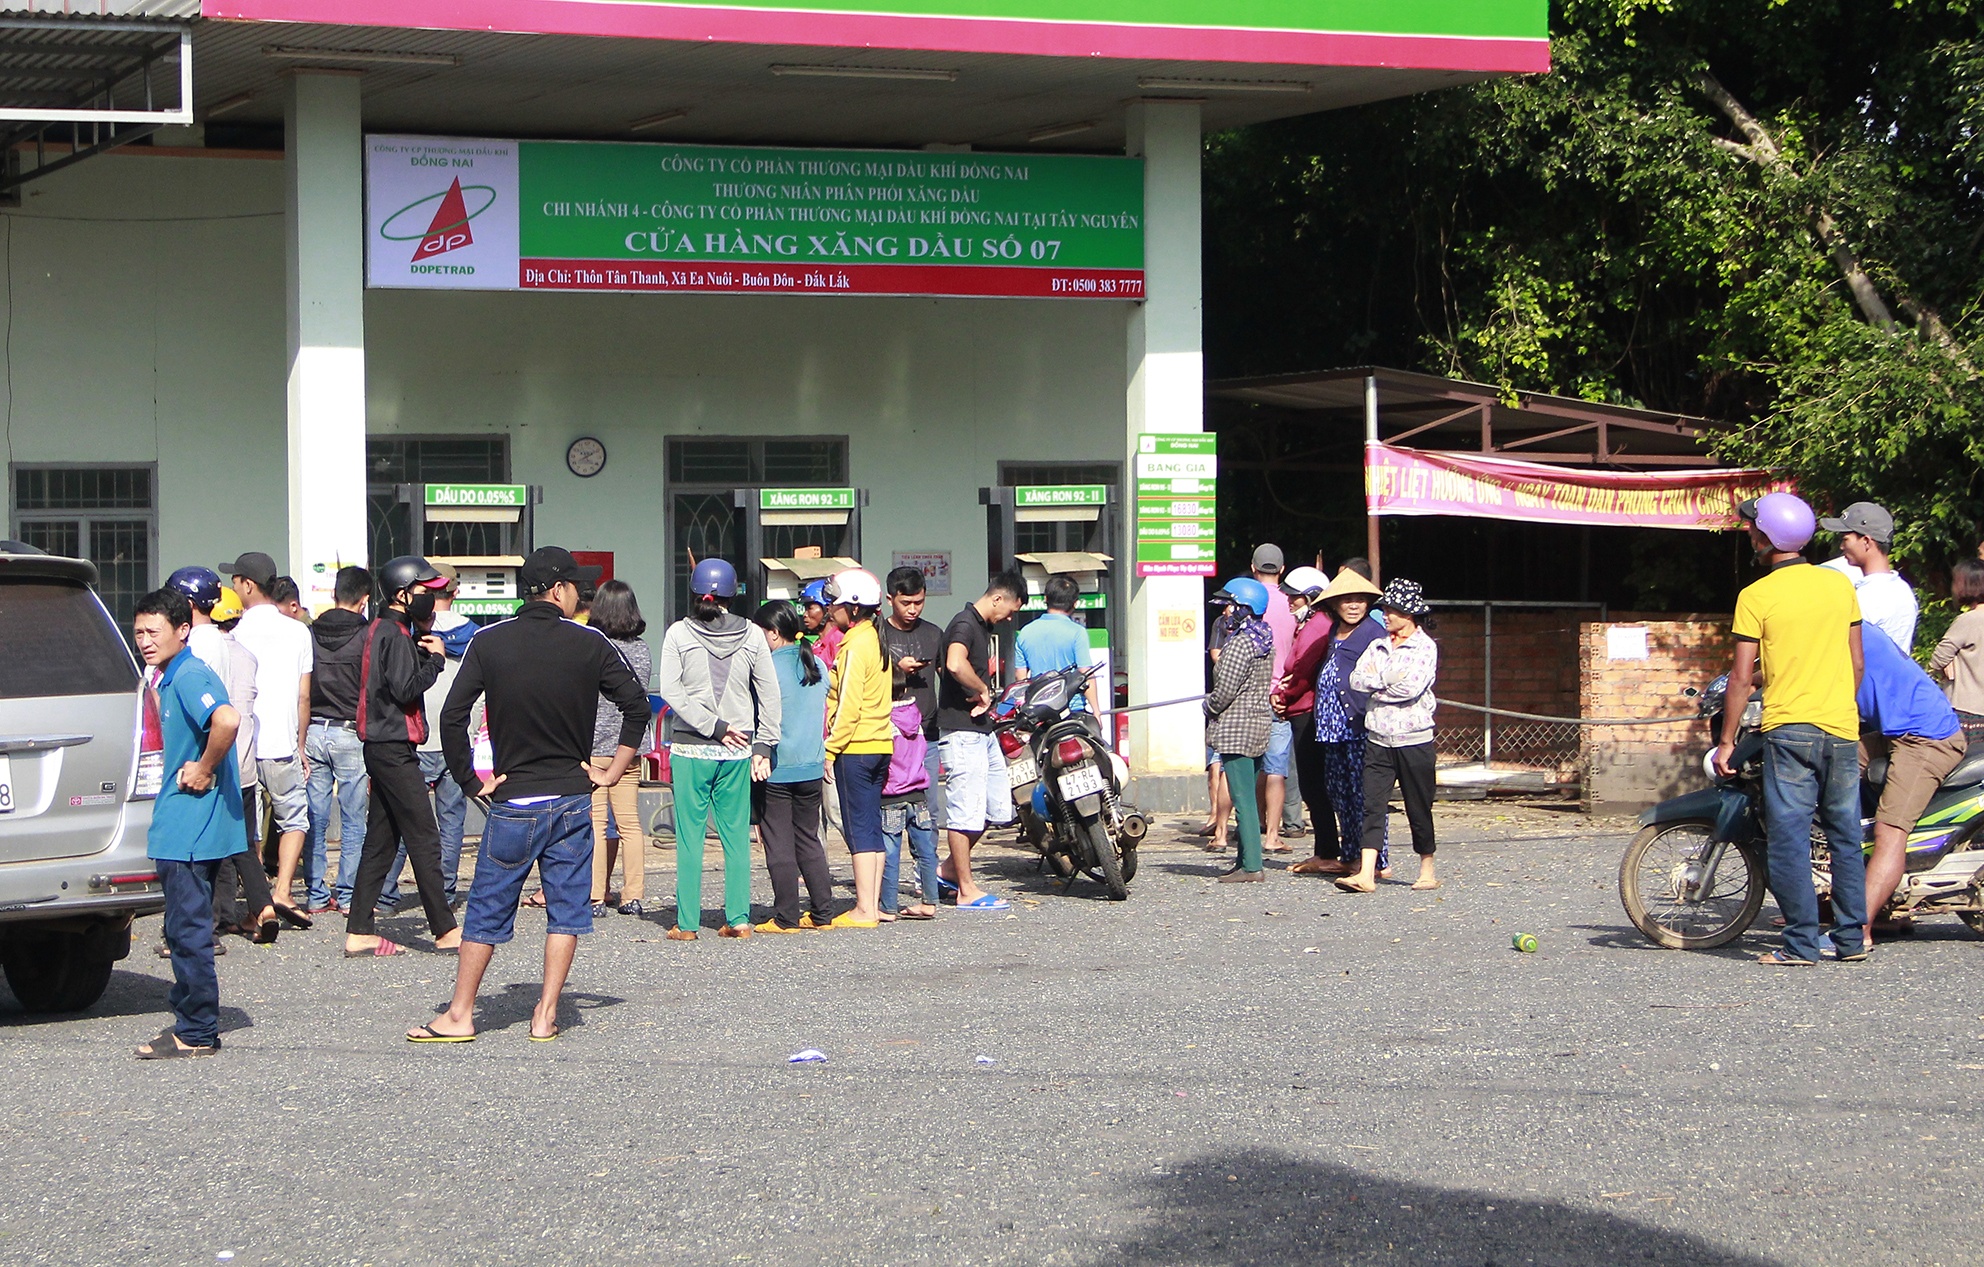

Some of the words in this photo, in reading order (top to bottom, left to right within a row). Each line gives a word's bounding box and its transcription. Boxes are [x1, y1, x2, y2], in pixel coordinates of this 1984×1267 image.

[452, 158, 474, 168] NAI
[661, 153, 704, 173] CÔNG
[707, 158, 728, 173] TY
[798, 159, 861, 177] THƯƠNG
[864, 162, 893, 180] MẠI
[930, 161, 956, 179] KHÍ
[1004, 166, 1029, 181] NAI
[713, 182, 777, 199] THƯƠNG
[780, 182, 821, 200] NHÂN
[826, 183, 864, 201] PHÂN
[907, 184, 947, 203] XĂNG
[543, 202, 570, 216] CHI
[574, 198, 628, 218] NHÁNH
[632, 204, 639, 218] 4
[651, 200, 694, 219] CÔNG
[697, 205, 717, 219] TY
[788, 206, 851, 223] THƯƠNG
[855, 209, 882, 226] MẠI
[920, 207, 946, 224] KHÍ
[994, 212, 1019, 226] NAI
[1022, 212, 1046, 230] TẠI
[1049, 210, 1078, 228] TÂY
[1081, 211, 1139, 229] NGUYÊN
[624, 226, 696, 253] CỬA
[704, 228, 799, 256] HÀNG
[807, 230, 898, 257] XĂNG
[908, 232, 973, 258] DẦU
[982, 233, 1022, 259] SỐ
[1030, 240, 1061, 260] 07
[410, 265, 475, 275] DOPETRAD
[526, 269, 544, 286] Địa
[574, 269, 602, 284] Thôn
[606, 270, 627, 285] Tân
[630, 270, 668, 287] Thanh,
[671, 271, 686, 285] Xã
[690, 271, 704, 285] Ea
[707, 271, 732, 286] Nuôi
[742, 272, 770, 286] Buôn
[773, 273, 794, 287] Đôn
[804, 270, 826, 288] Đắk
[829, 270, 850, 288] Lắk
[1098, 279, 1116, 292] 383
[1119, 280, 1142, 293] 7777
[1400, 459, 1429, 505] LIỆT
[460, 490, 476, 504] DO
[477, 490, 516, 504] 0.05%S
[770, 491, 797, 505] XĂNG
[799, 493, 820, 505] RON
[821, 493, 833, 505] 92
[1025, 490, 1051, 502] XĂNG
[1052, 491, 1072, 502] RON
[1073, 490, 1085, 501] 92
[460, 603, 476, 615] DO
[477, 603, 514, 615] 0.05%S
[1006, 761, 1030, 777] 7-S1
[1068, 779, 1098, 797] 2193
